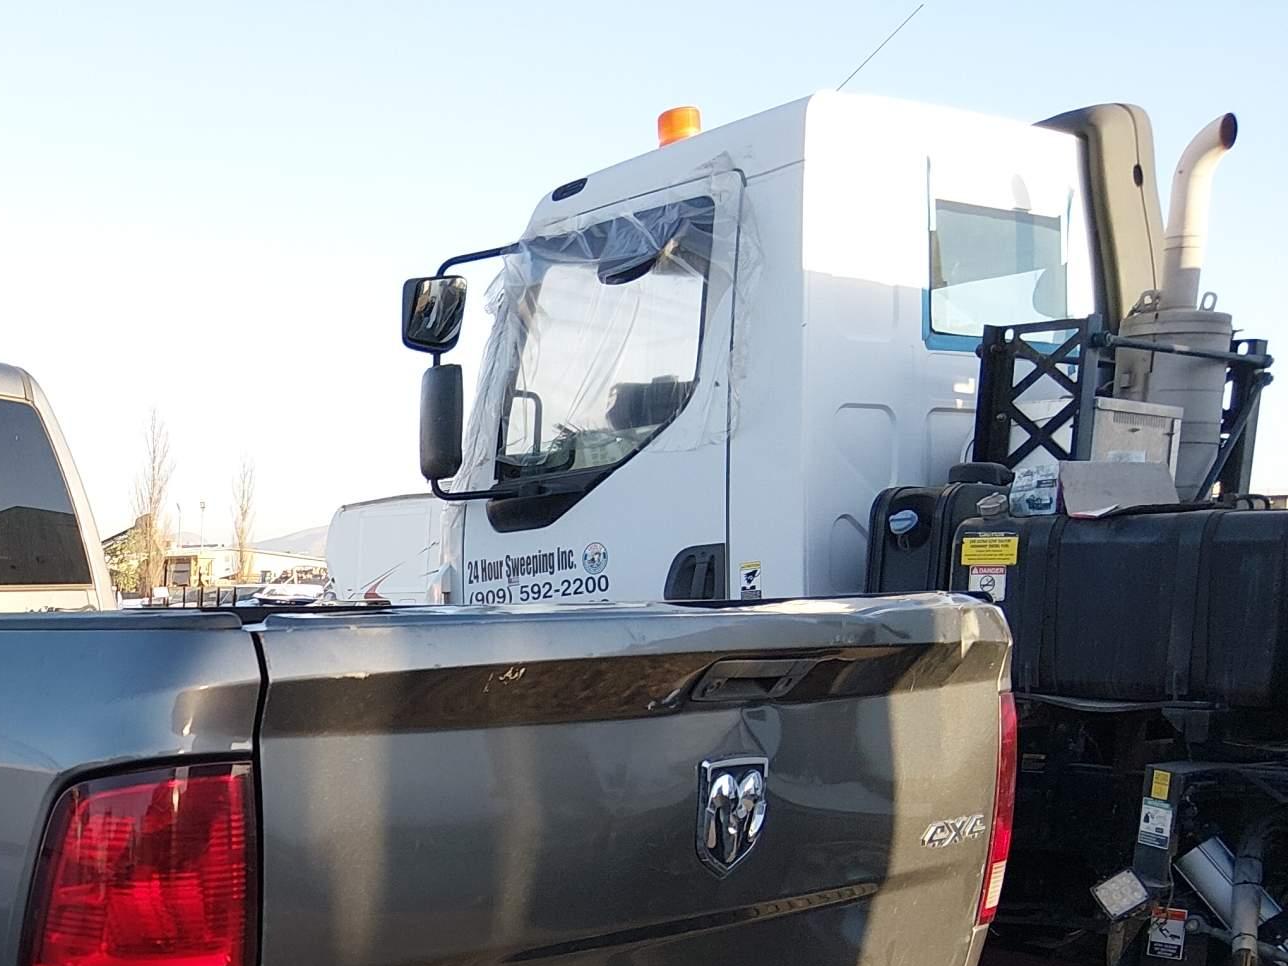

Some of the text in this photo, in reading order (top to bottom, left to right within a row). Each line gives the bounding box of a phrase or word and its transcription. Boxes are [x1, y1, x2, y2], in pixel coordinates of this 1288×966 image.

[468, 560, 479, 584] 24
[481, 558, 503, 582] Hour
[505, 549, 555, 577] Sweeping
[557, 547, 577, 571] Inc.
[469, 574, 609, 604] (909) 592-2200
